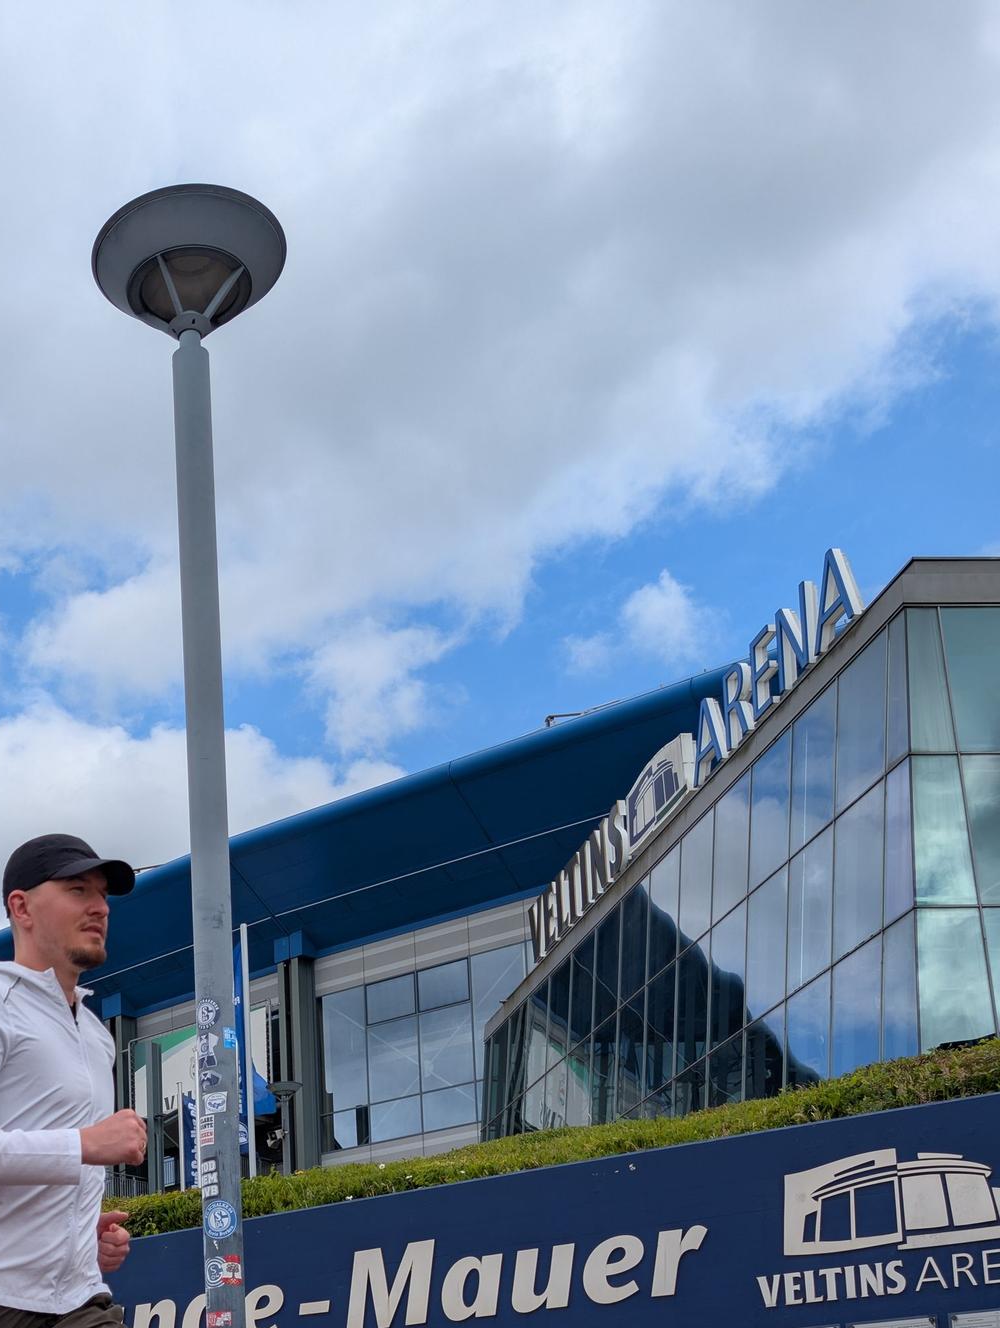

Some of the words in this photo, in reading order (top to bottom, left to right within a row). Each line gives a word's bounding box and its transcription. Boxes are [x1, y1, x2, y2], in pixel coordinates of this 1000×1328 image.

[528, 800, 630, 964] VELTINS
[693, 548, 864, 787] ARENA
[202, 1172, 218, 1187] EM
[202, 1184, 219, 1199] VB
[756, 1260, 907, 1308] VELTINS
[915, 1250, 1000, 1292] ARE
